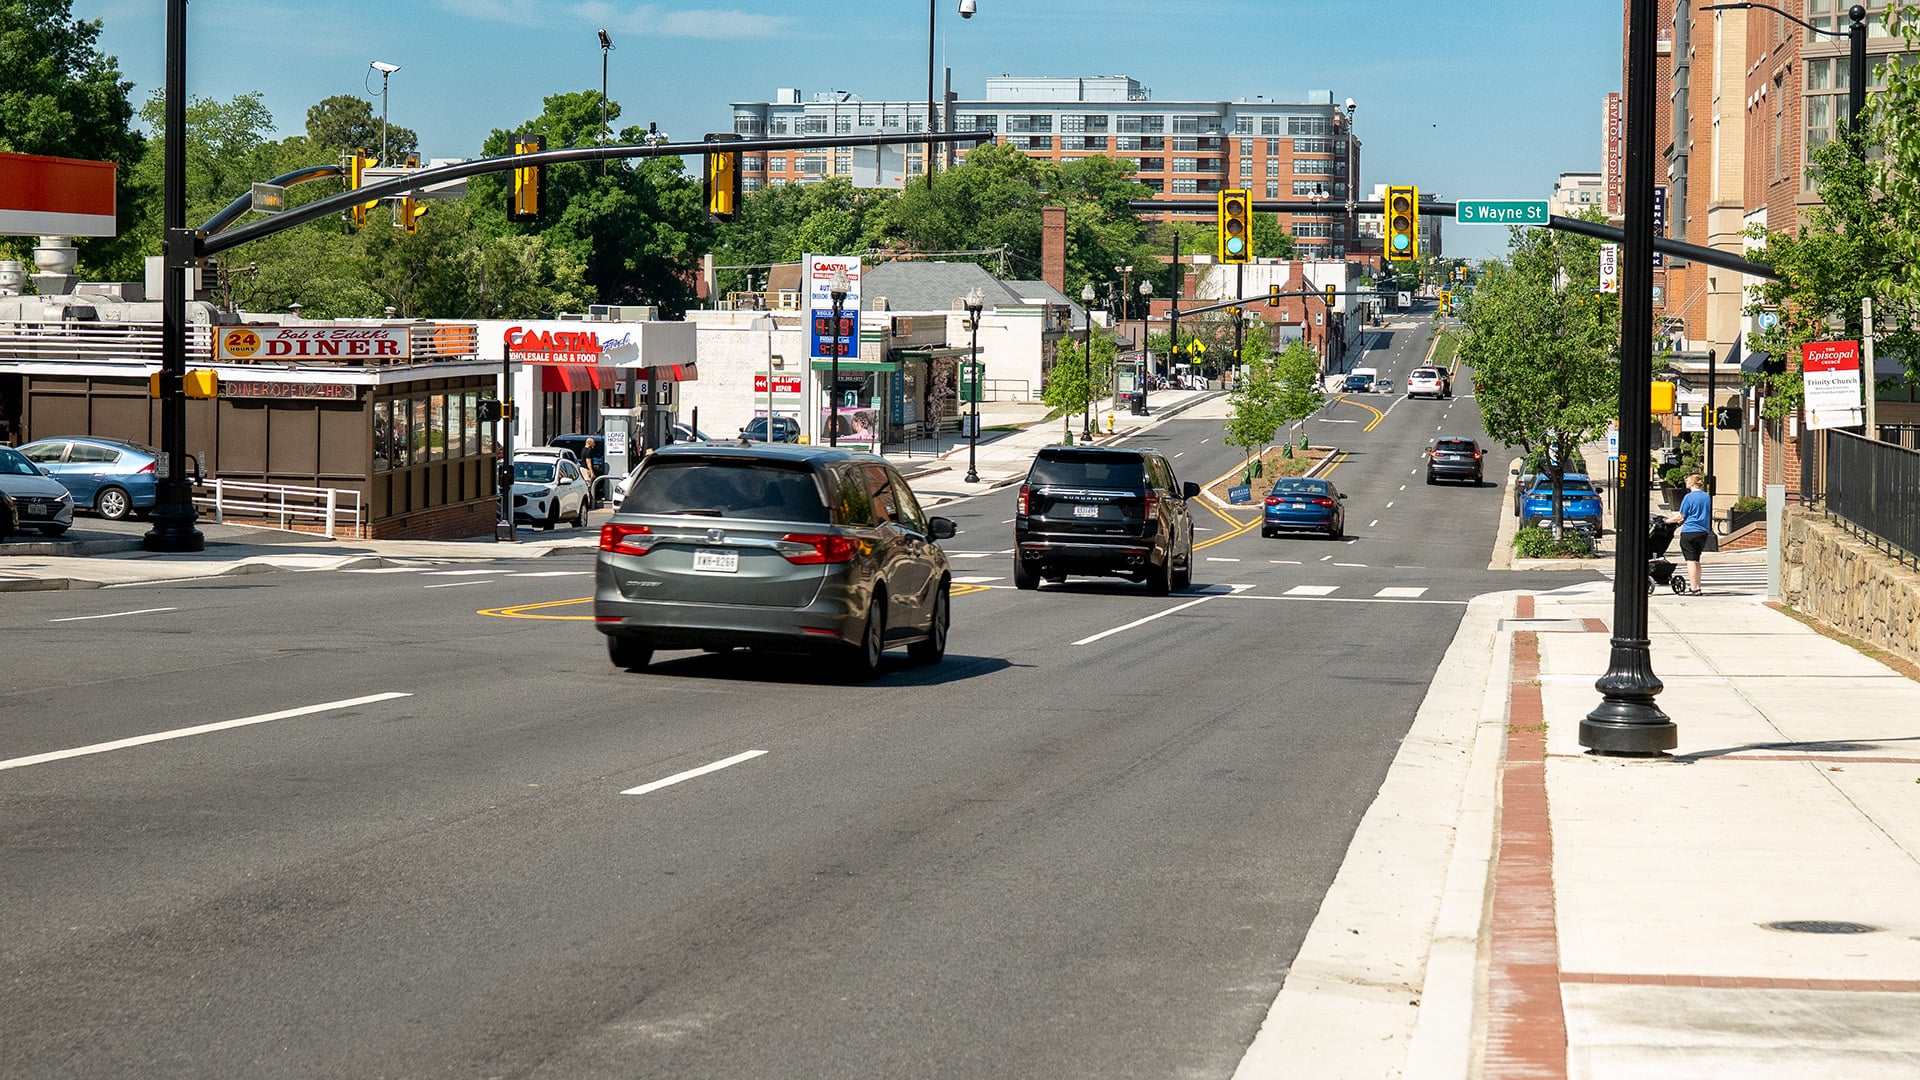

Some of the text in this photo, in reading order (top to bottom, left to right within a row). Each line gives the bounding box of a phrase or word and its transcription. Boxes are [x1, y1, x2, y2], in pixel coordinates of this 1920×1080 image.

[1610, 96, 1618, 196] PENROSE SQUARE
[1653, 189, 1661, 225] SIENA
[1464, 205, 1542, 222] S Wayne St
[813, 262, 848, 271] COASTAL
[1603, 246, 1614, 275] Giant
[228, 334, 256, 346] 24
[276, 329, 389, 340] Bob & Edith's
[504, 327, 603, 353] COASTAL
[265, 339, 401, 356] DINER
[552, 353, 568, 362] GAS
[569, 353, 575, 362] &
[576, 353, 597, 363] FOOD
[1808, 349, 1854, 361] Episcopal
[662, 382, 668, 391] 6
[1831, 377, 1857, 385] Church
[228, 383, 270, 396] DINER
[616, 383, 622, 392] 7
[641, 383, 647, 393] 8
